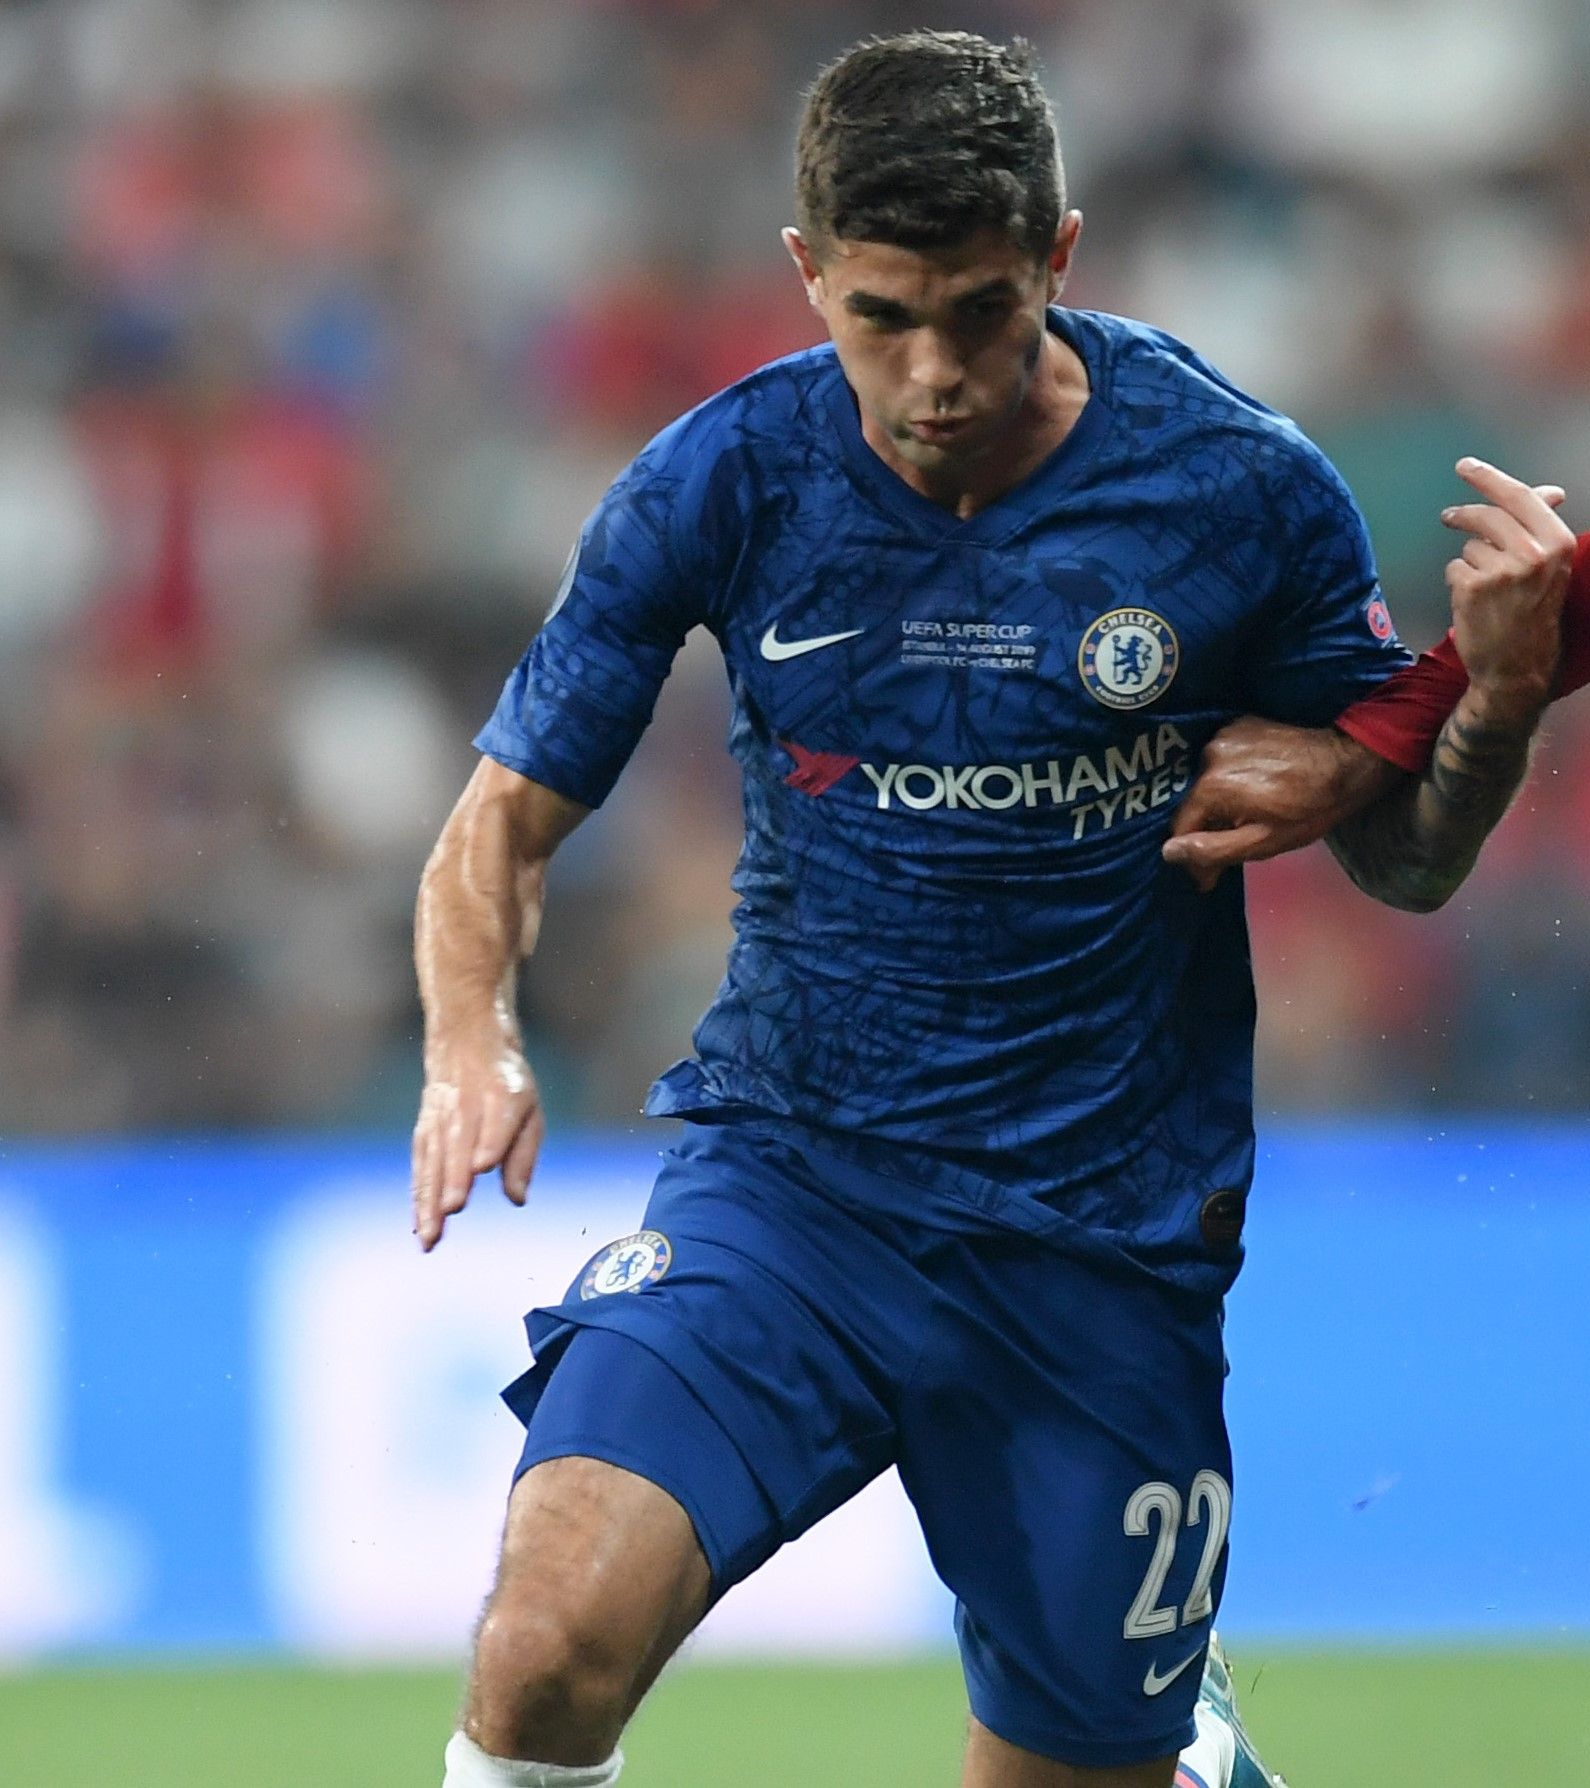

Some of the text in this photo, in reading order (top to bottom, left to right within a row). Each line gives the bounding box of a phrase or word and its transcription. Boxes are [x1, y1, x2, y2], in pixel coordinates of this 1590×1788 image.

[901, 620, 1033, 639] UEFA SUPER CUP
[1098, 613, 1162, 635] CHELSEA
[860, 723, 1188, 810] YOKOHAMA
[1069, 753, 1189, 840] TYRES
[1123, 1468, 1232, 1639] 22
